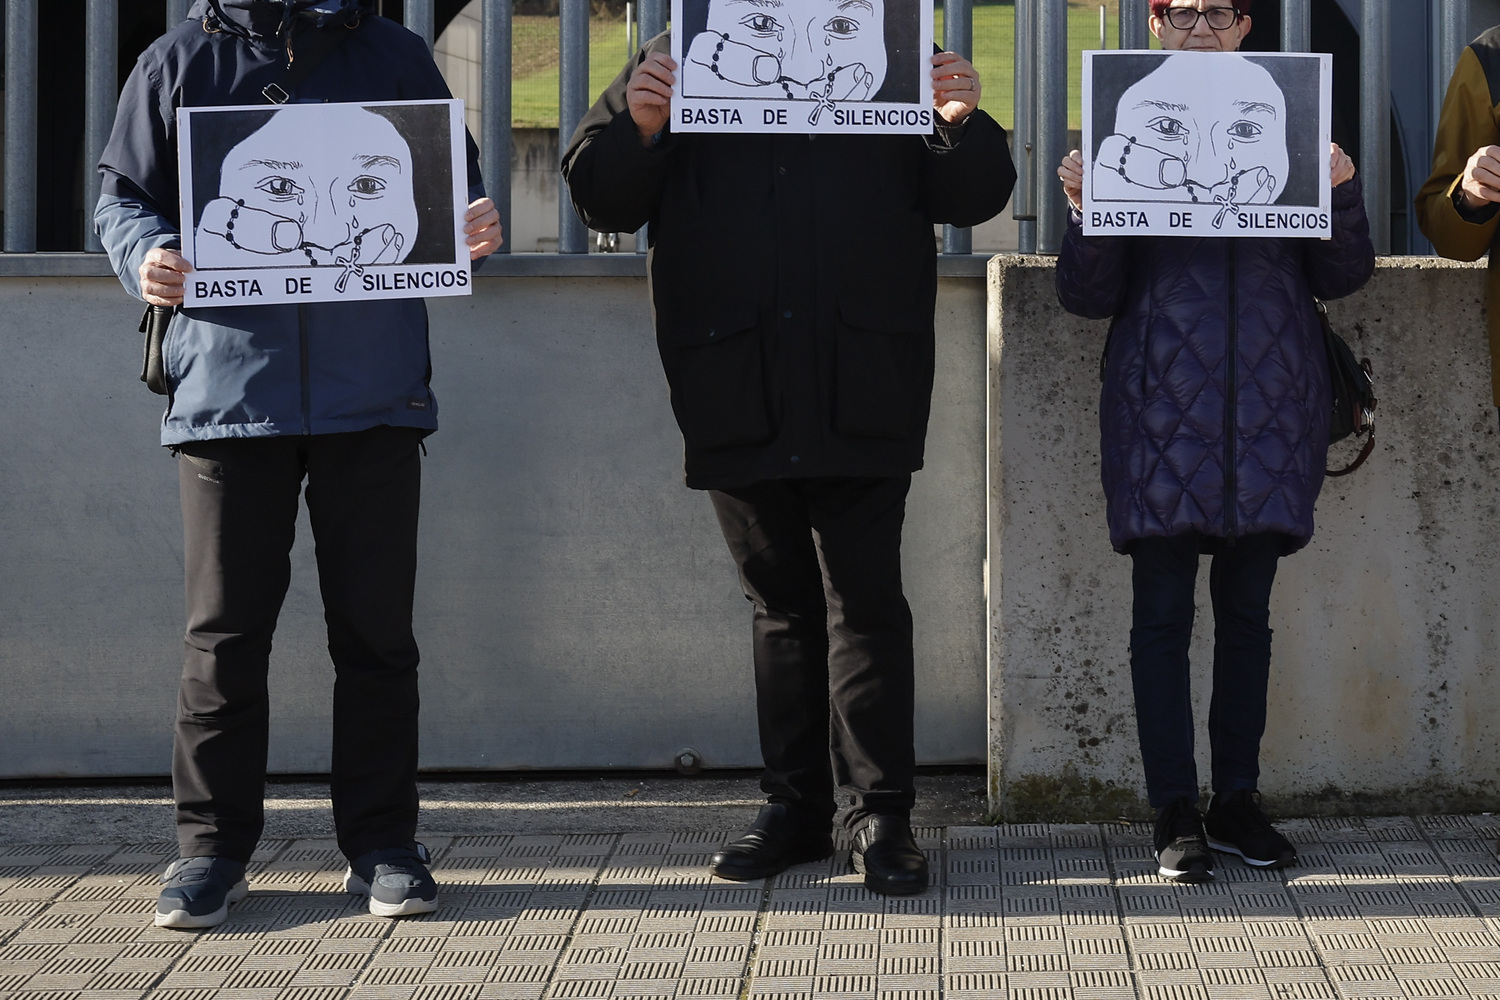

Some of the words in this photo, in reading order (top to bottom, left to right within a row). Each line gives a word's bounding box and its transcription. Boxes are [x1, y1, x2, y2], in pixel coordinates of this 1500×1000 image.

[682, 109, 742, 124] BASTA
[764, 110, 787, 124] DE
[834, 110, 930, 125] SILENCIOS
[1092, 212, 1148, 227] BASTA
[1170, 212, 1192, 227] DE
[1238, 213, 1328, 229] SILENCIOS
[196, 280, 262, 298] BASTA
[286, 277, 311, 294] DE
[363, 269, 468, 291] SILENCIOS
